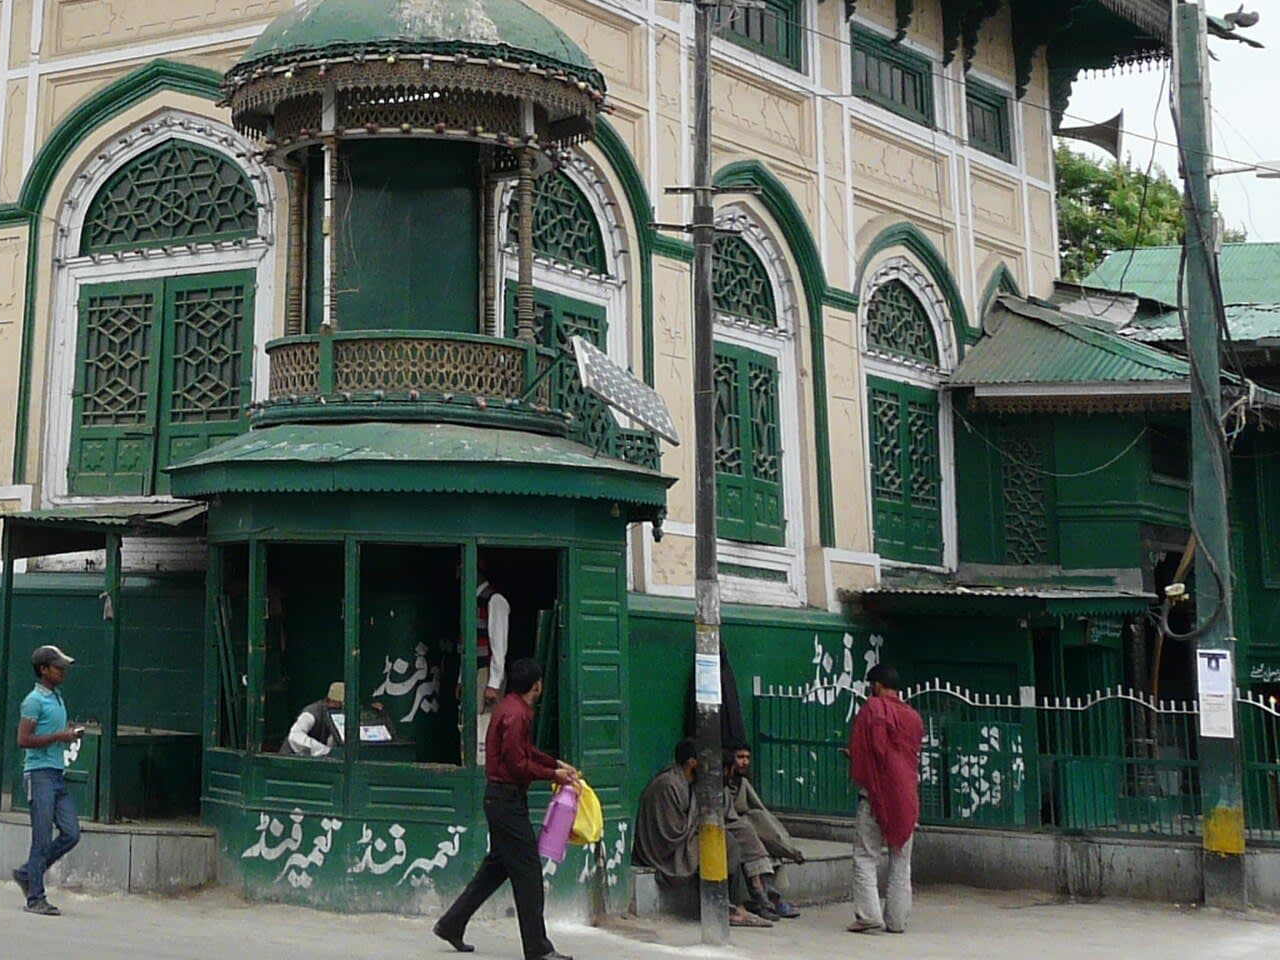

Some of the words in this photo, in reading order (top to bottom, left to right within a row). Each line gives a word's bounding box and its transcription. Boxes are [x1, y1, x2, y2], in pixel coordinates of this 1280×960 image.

[372, 640, 429, 697] فنڈ
[241, 807, 305, 861] فنڈ
[273, 817, 343, 889] تعمیر
[347, 823, 408, 875] فنڈ
[395, 825, 469, 888] تعمیر
